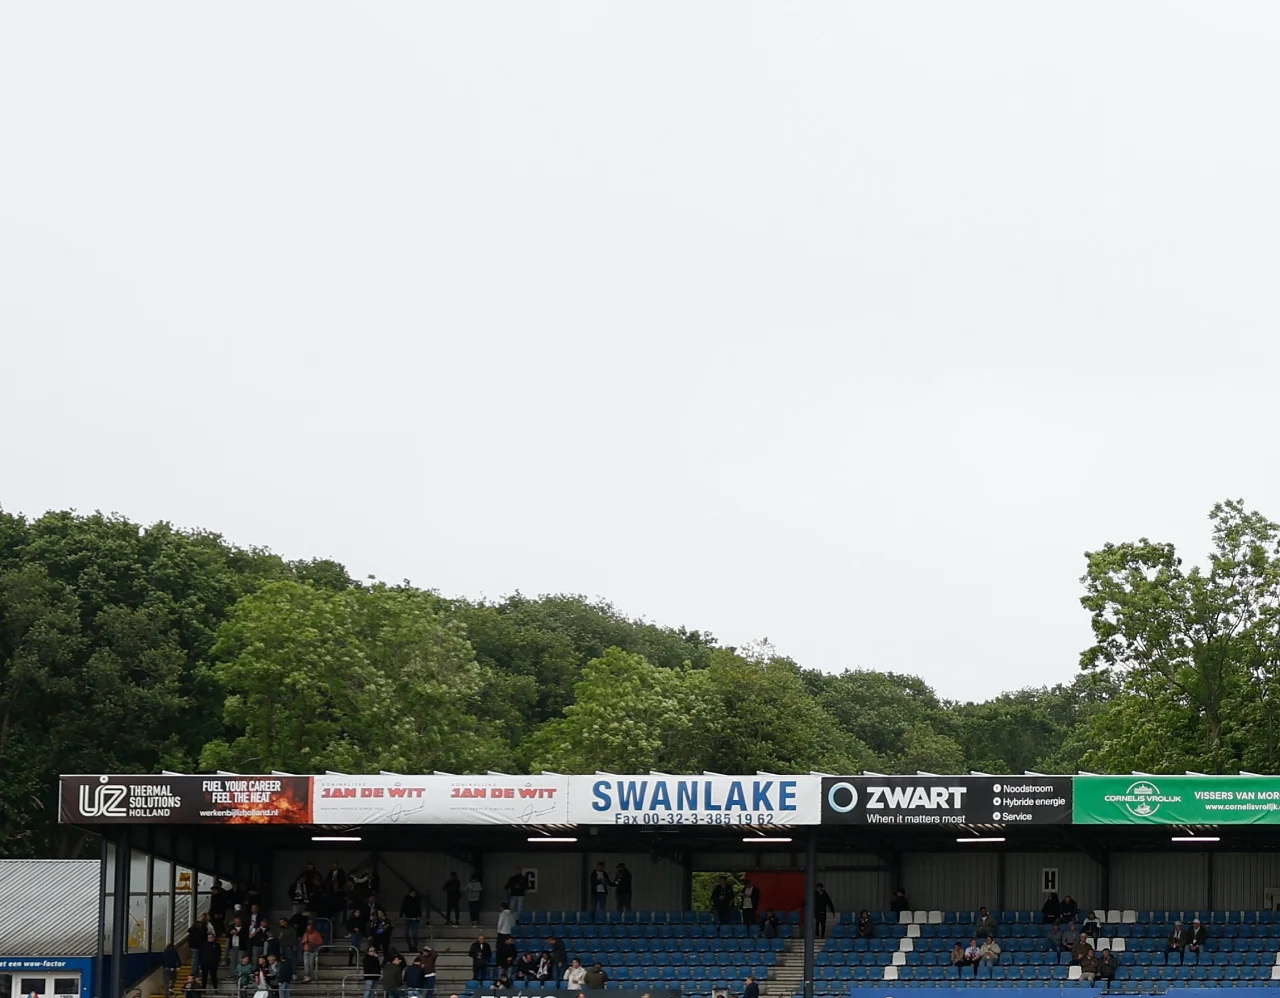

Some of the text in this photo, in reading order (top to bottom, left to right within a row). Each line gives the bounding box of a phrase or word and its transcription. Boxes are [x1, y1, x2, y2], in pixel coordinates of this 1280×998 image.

[130, 785, 173, 796] THERMAL
[202, 780, 281, 792] FUEL YOUR CAREER
[1003, 783, 1053, 793] Noodstroom
[212, 792, 271, 803] FEEL THE HEAT
[321, 787, 426, 799] JAN DE WIT
[450, 788, 557, 799] JAN DE WIT
[591, 780, 798, 812] SWANLAKE
[866, 786, 967, 809] ZWART
[1194, 791, 1232, 800] VISSERS
[1235, 791, 1256, 800] VAN
[129, 796, 181, 808] SOLUTIONS
[1003, 797, 1065, 808] Hybride energie
[129, 808, 171, 817] HOLLAND
[867, 813, 966, 823] When it matters most
[1002, 811, 1032, 821] Service
[615, 813, 639, 825] Fax
[737, 812, 753, 825] 19
[757, 812, 774, 825] 62
[1044, 870, 1056, 890] H
